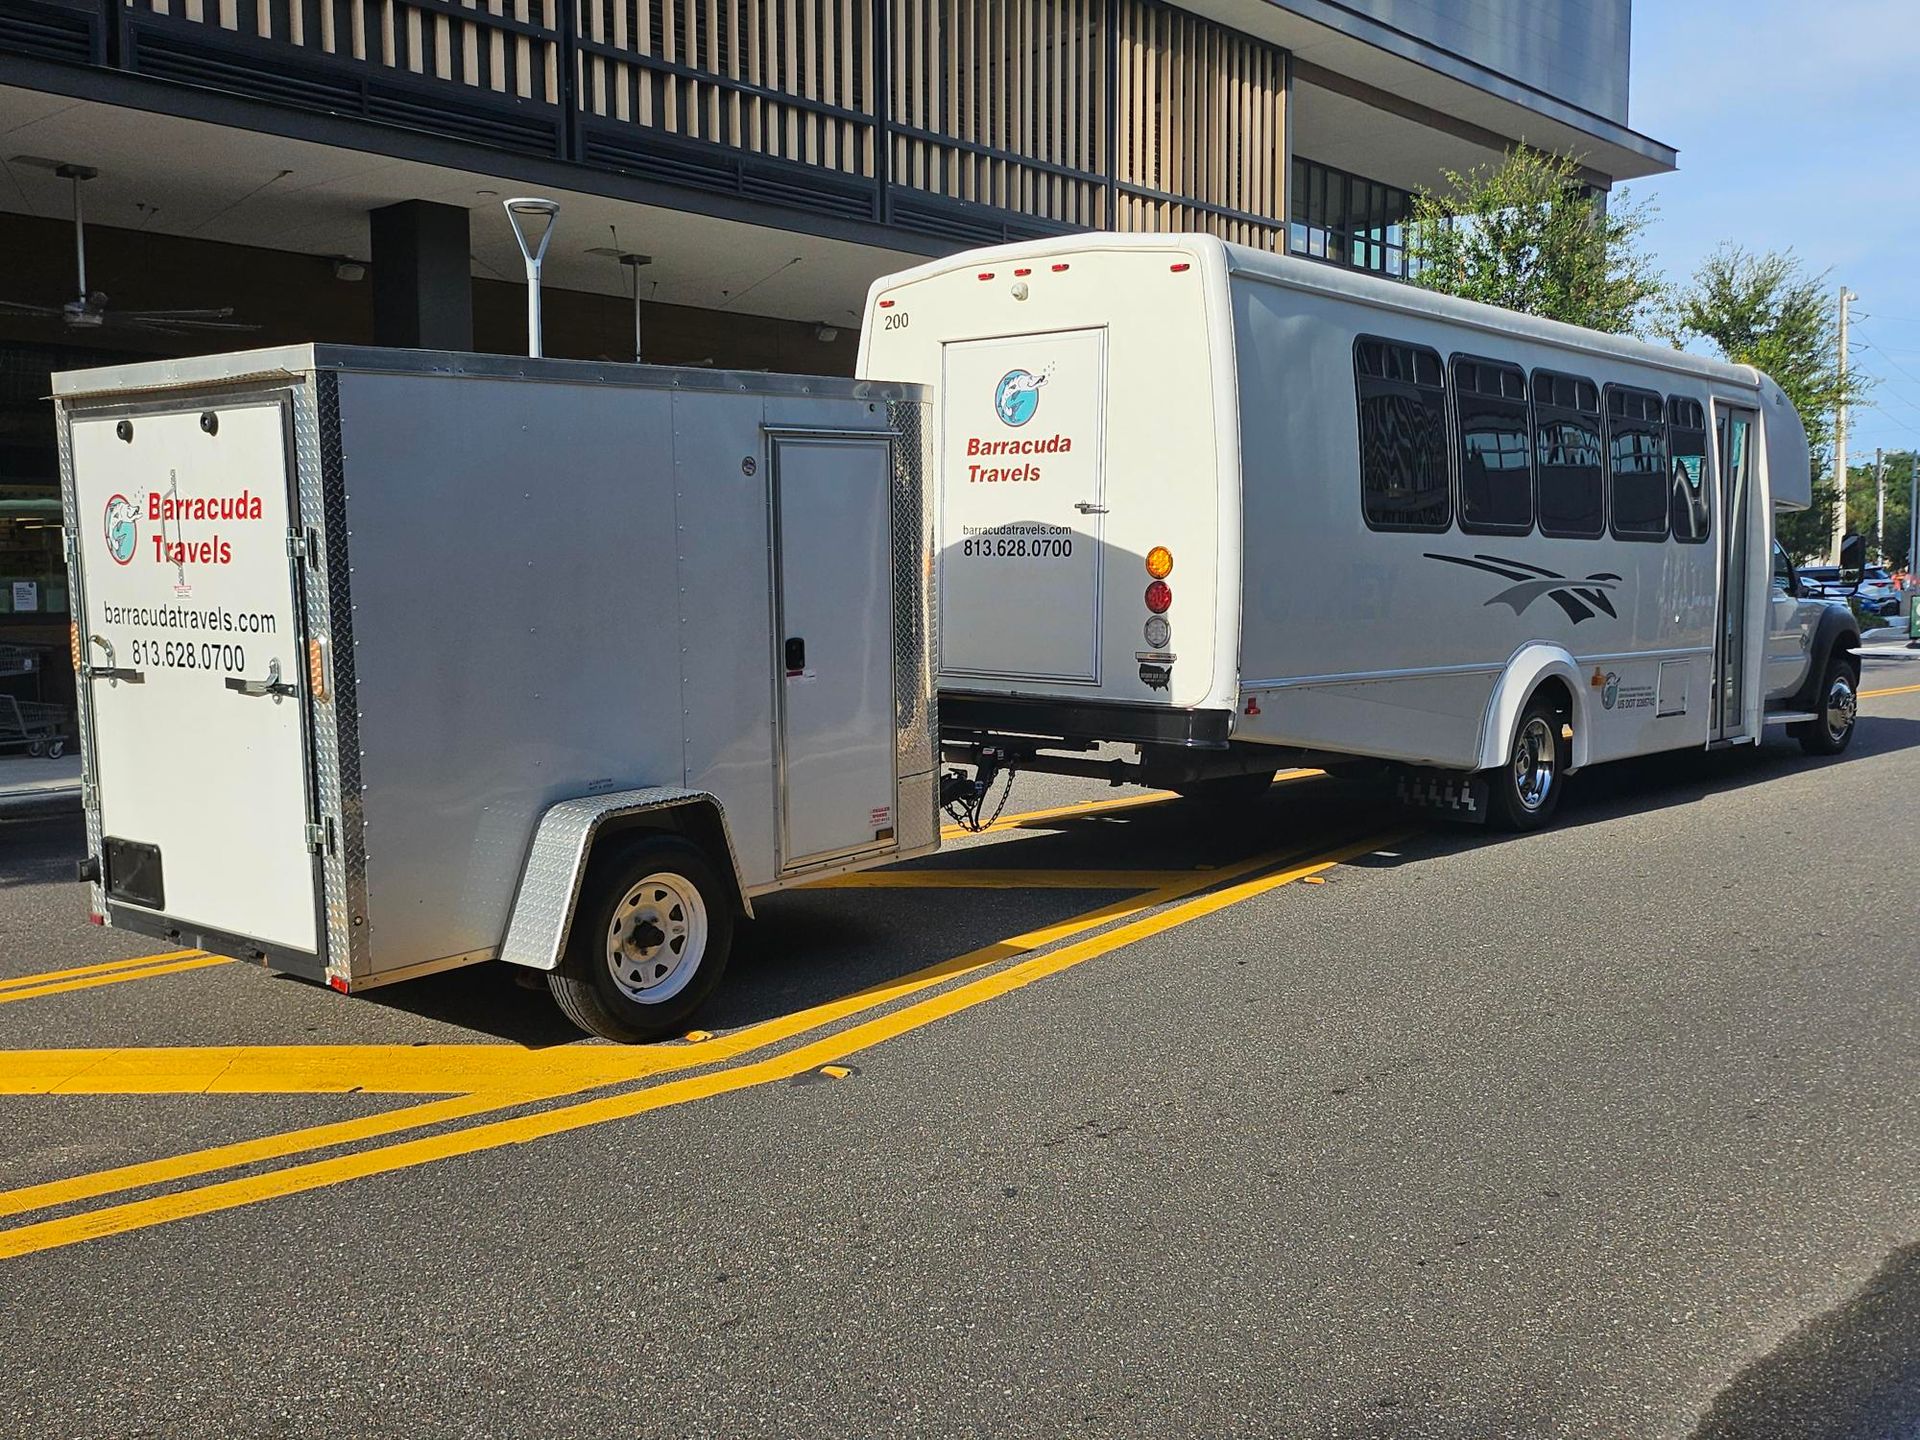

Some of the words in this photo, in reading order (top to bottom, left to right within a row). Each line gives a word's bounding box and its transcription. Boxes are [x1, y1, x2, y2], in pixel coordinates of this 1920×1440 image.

[885, 312, 909, 330] 200
[967, 434, 1072, 456] Barracuda
[968, 463, 1041, 483] Travels
[148, 489, 263, 521] Barracuda
[963, 524, 1072, 536] barracudatravels.com
[152, 535, 232, 564] Travels
[963, 539, 1072, 557] 813.628.0700
[104, 600, 277, 634] barracudatravels.com
[132, 639, 246, 673] 813.628.0700
